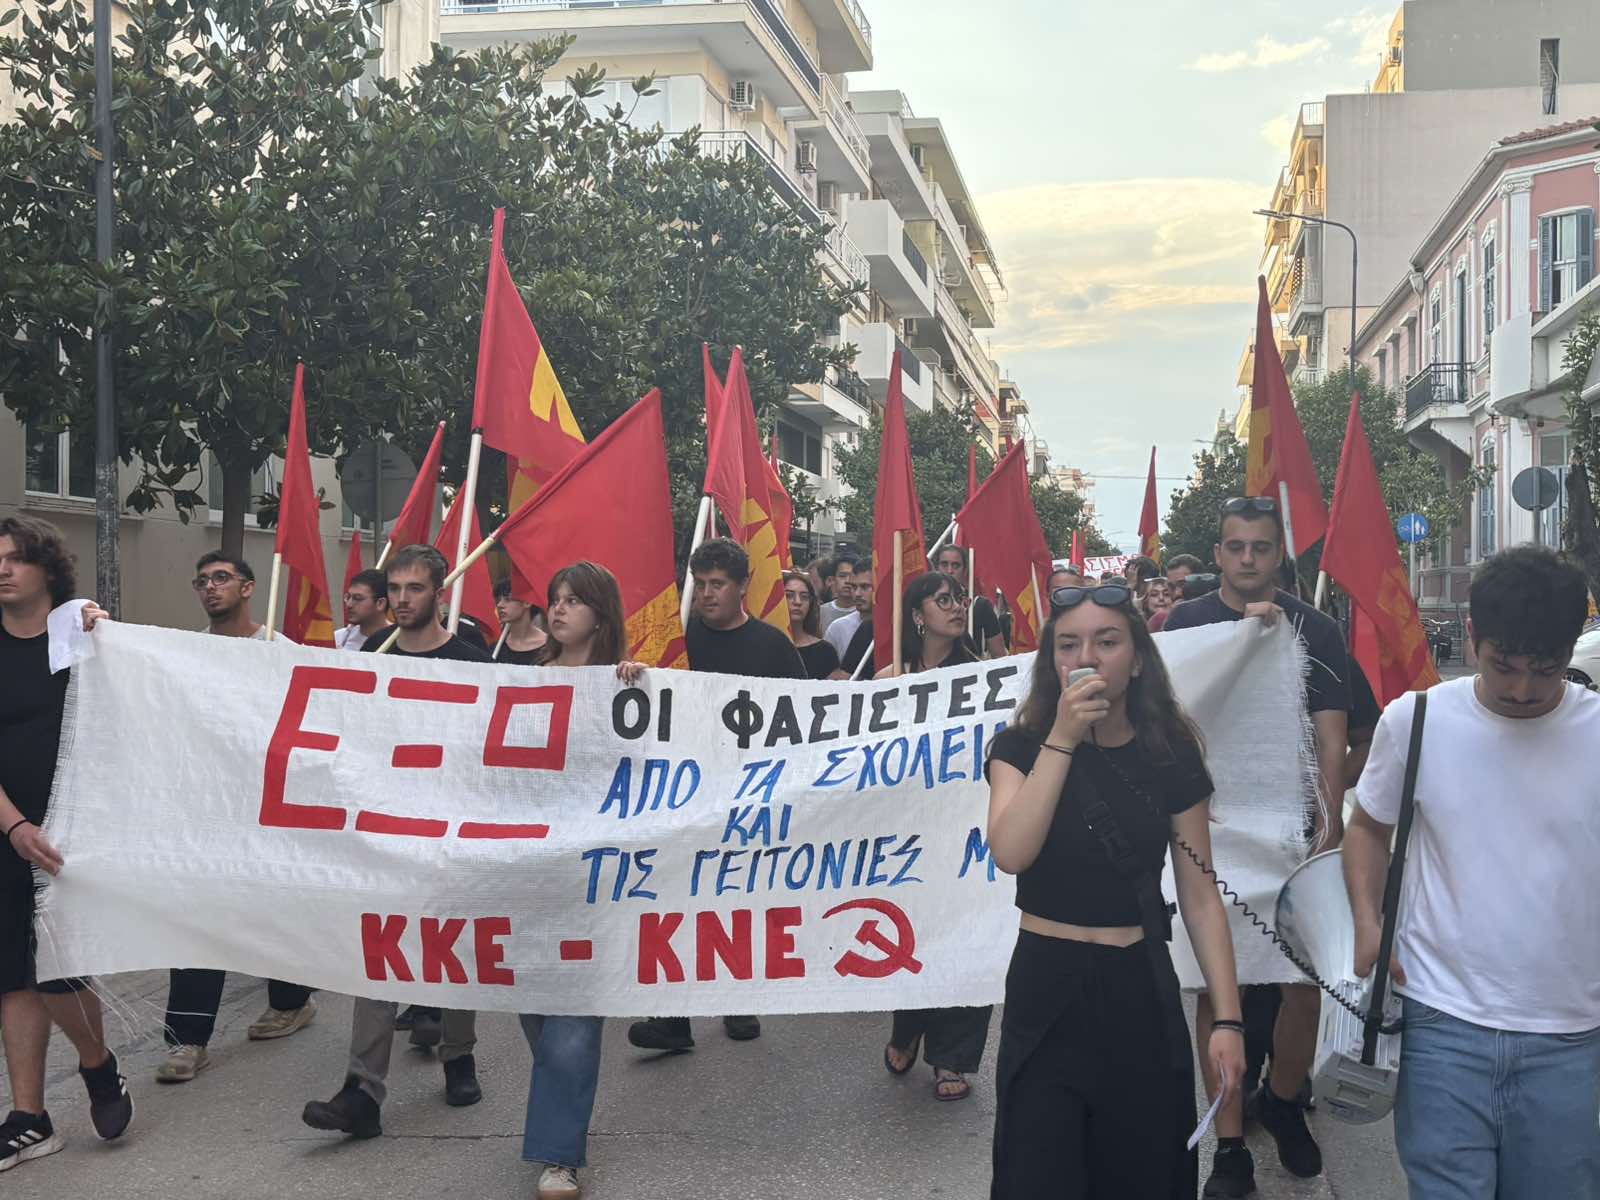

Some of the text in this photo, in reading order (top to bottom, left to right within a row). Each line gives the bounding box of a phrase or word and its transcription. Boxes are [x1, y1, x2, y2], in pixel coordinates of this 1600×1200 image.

[611, 666, 1017, 749] ΟΙ ΦΑΣΙΣΤΕΣ
[599, 722, 1006, 819] ΑΠΟ ΤΑ ΣΧΟΛΕΙ
[721, 804, 791, 846] ΚΑΙ
[582, 847, 657, 904] ΤΙΣ
[690, 834, 922, 896] ΓΕΙΤΟΝΙΕΣ
[361, 913, 515, 986] ΚΚΕ
[637, 906, 806, 985] ΚΝΕ
